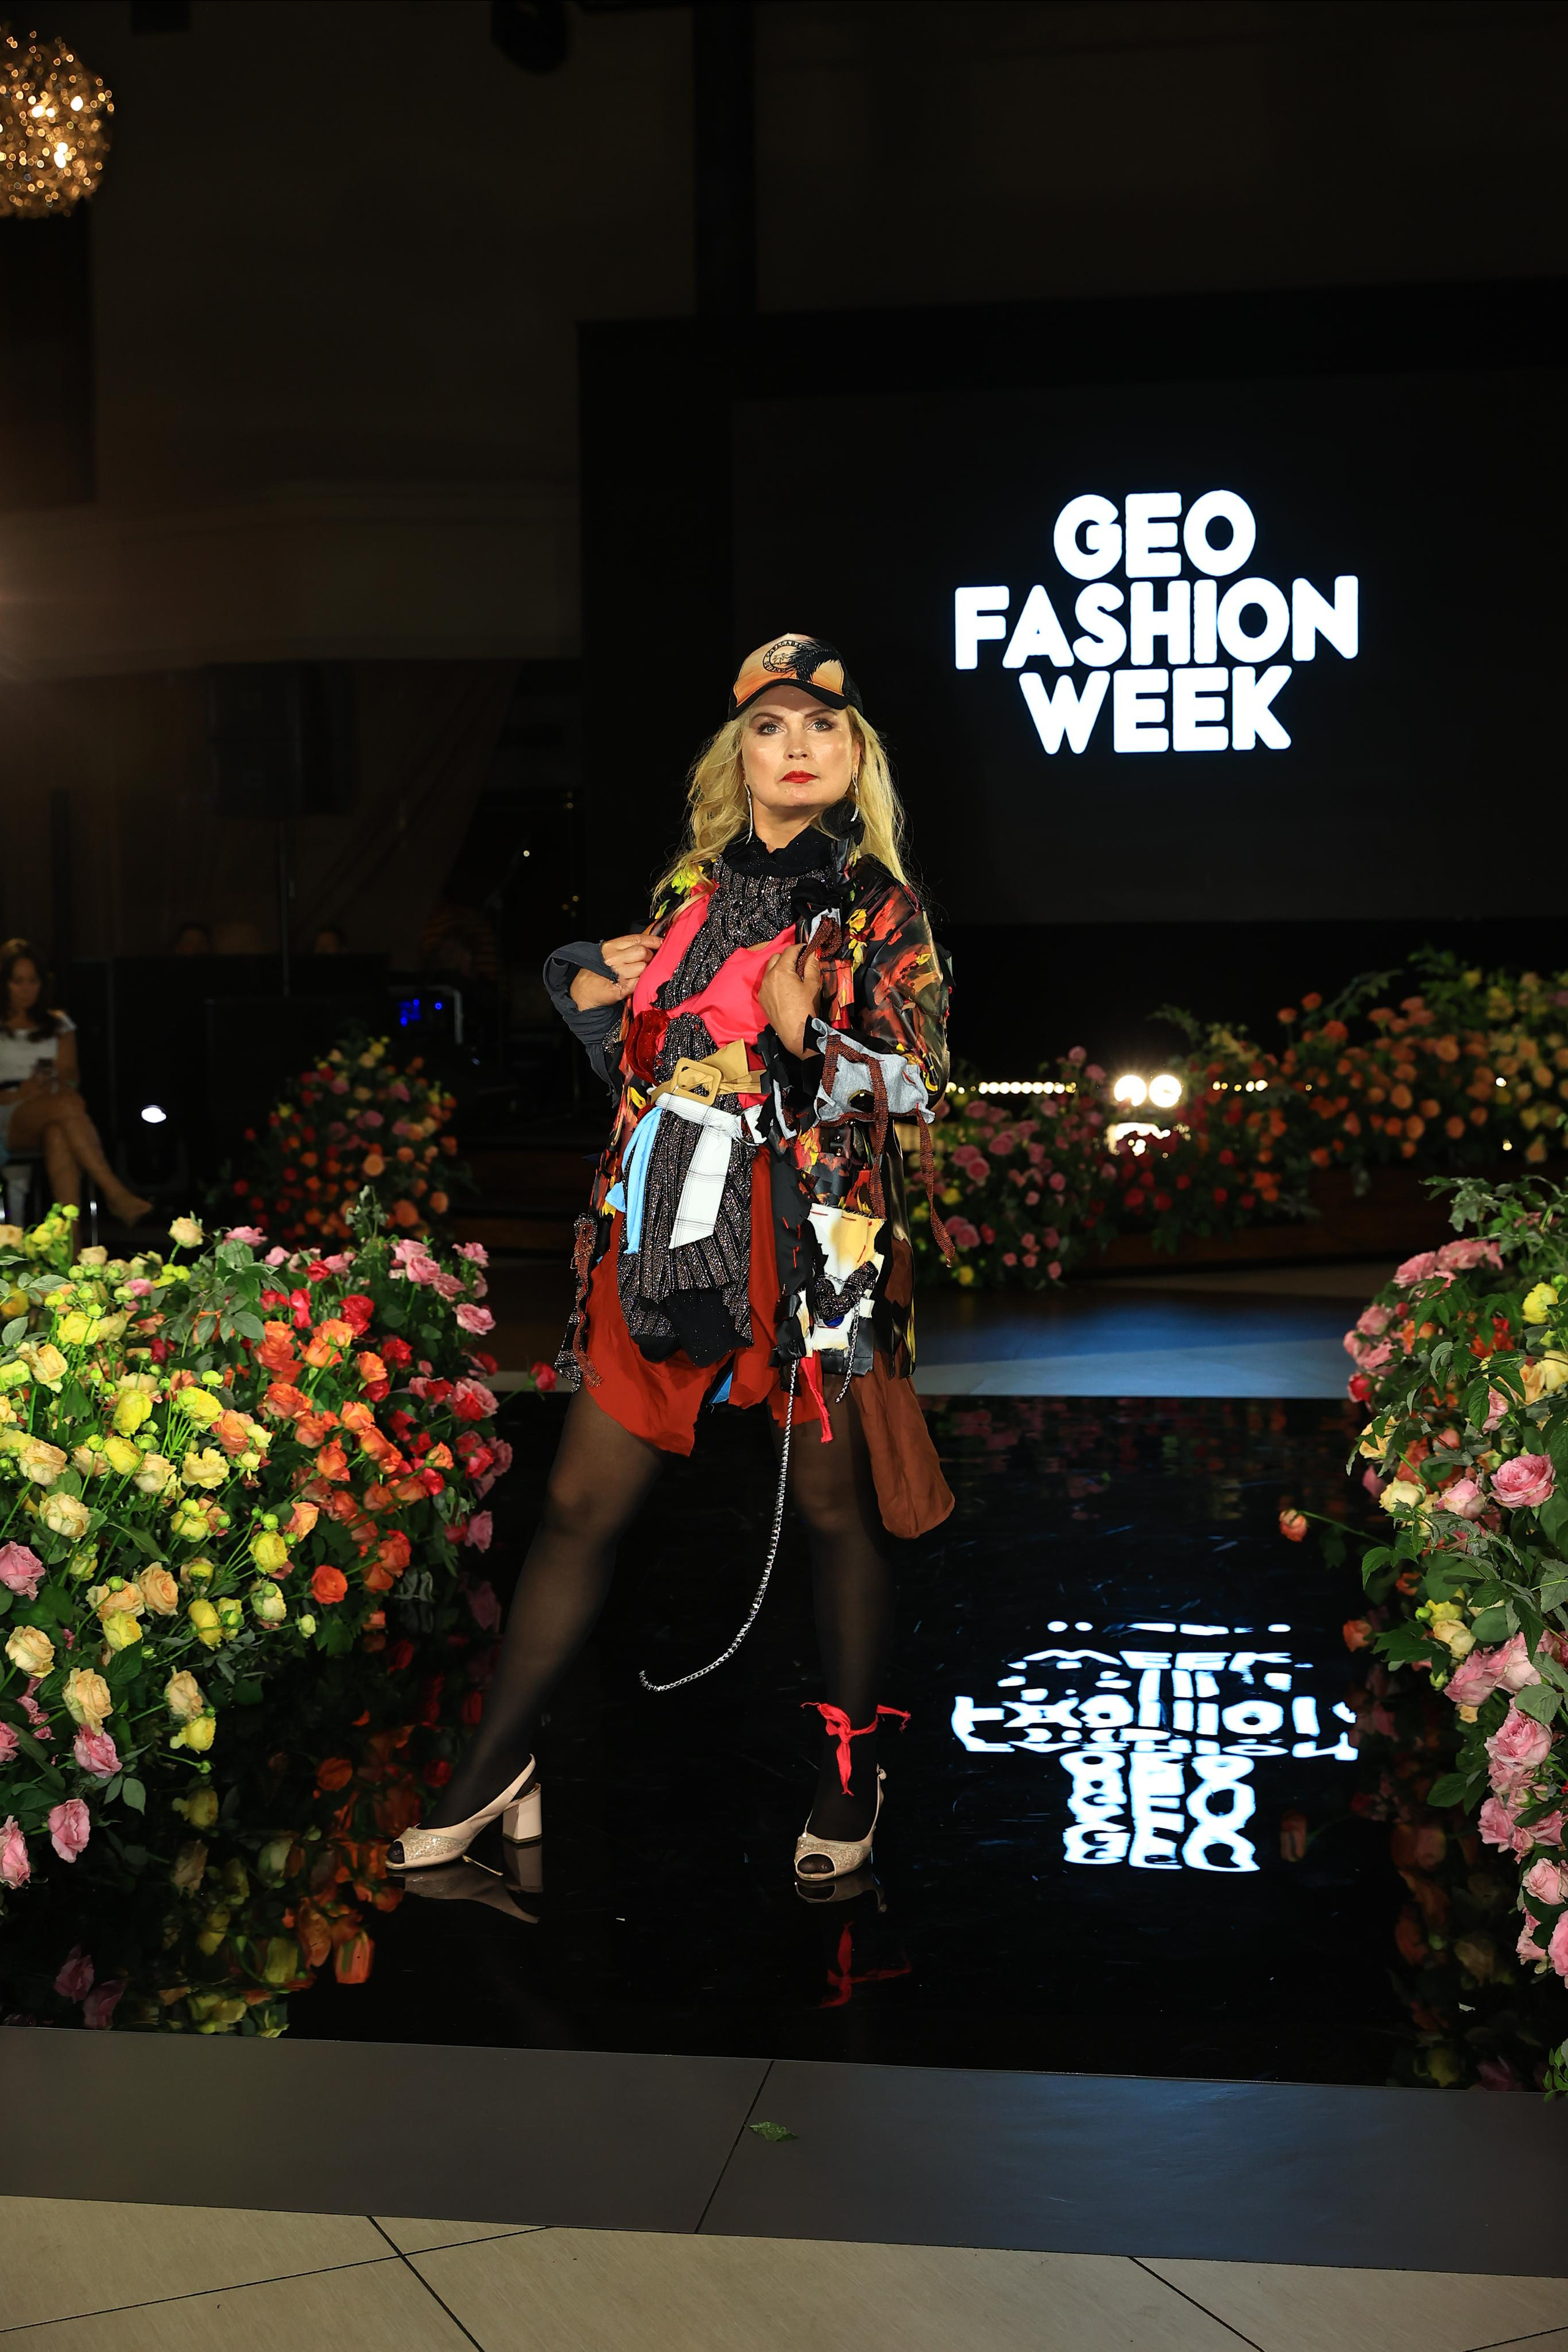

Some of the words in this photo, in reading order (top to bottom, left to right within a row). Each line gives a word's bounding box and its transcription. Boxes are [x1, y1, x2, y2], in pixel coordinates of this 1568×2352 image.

[1054, 490, 1256, 580] GEO
[955, 576, 1358, 669] FASHION
[1019, 666, 1292, 754] WEEK
